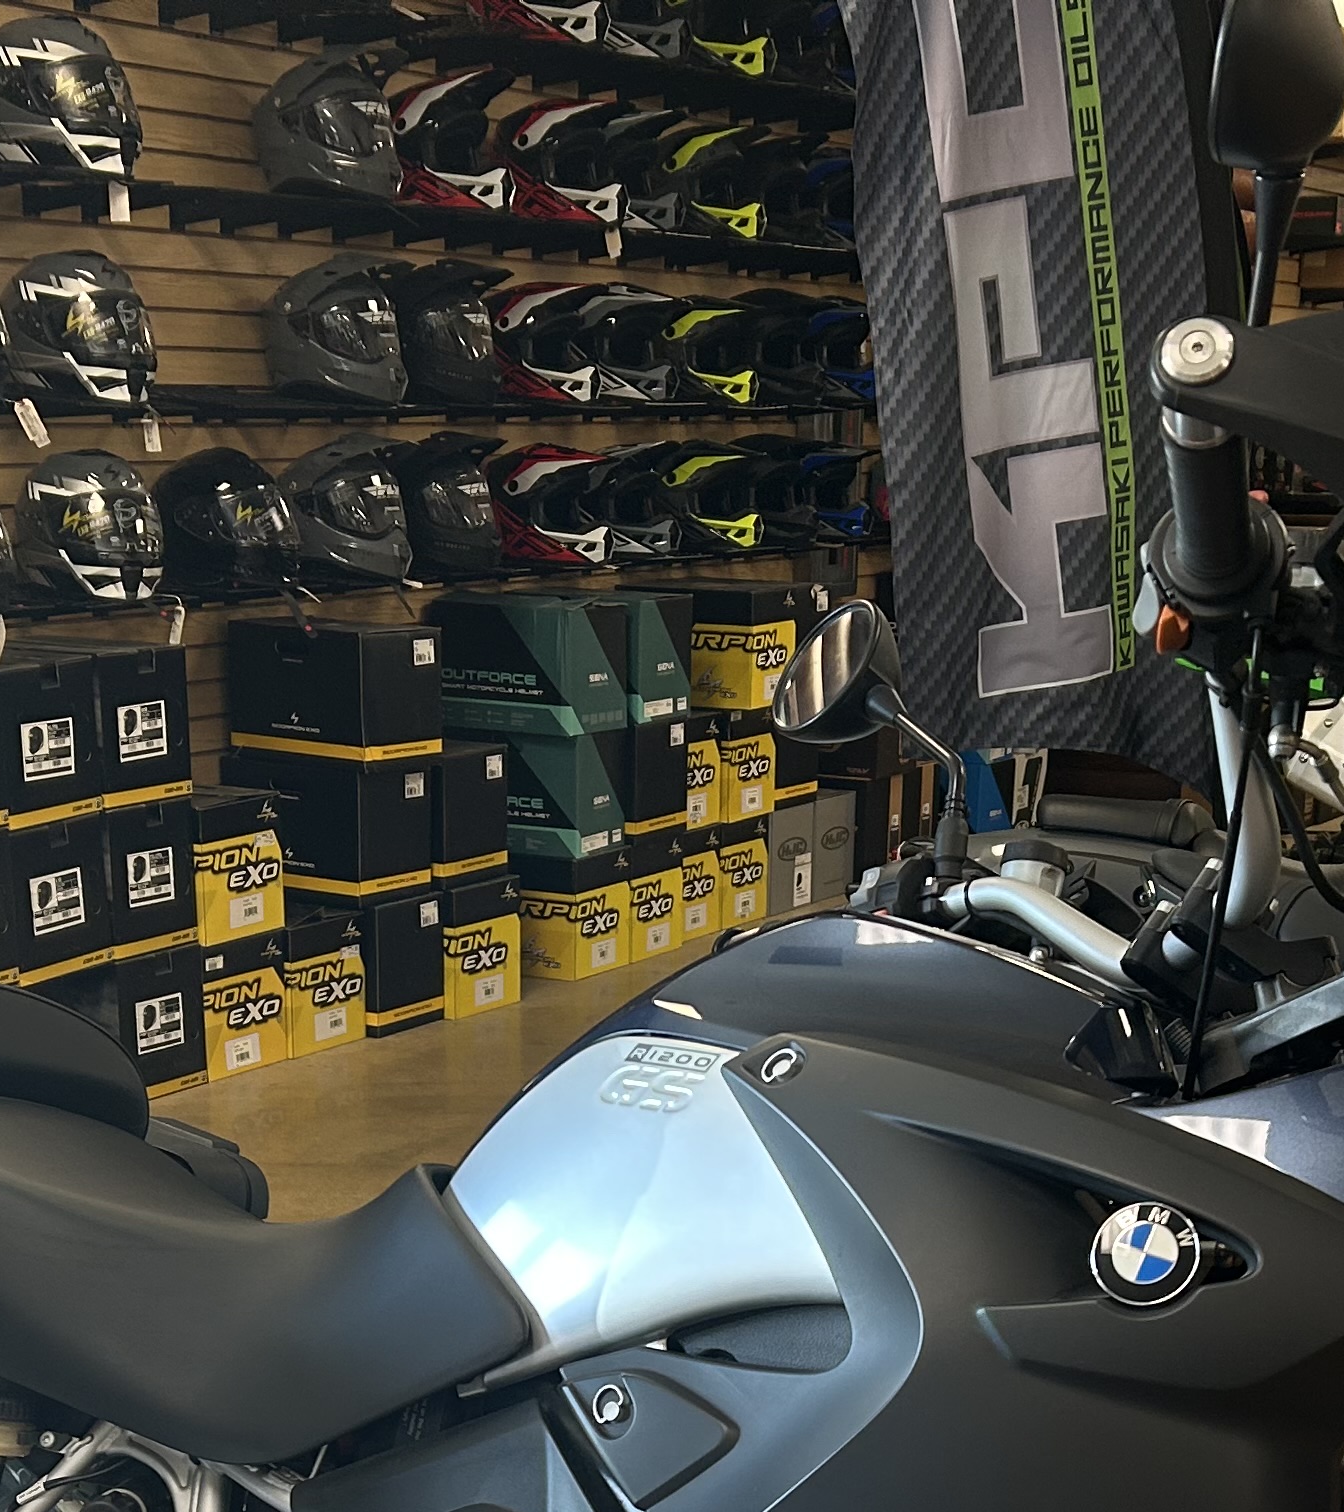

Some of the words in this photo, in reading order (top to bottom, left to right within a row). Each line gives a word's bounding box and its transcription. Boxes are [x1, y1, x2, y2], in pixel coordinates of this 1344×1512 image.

[1077, 106, 1128, 449] PERFORMANCE
[1107, 453, 1133, 669] KAWASAKI
[442, 668, 537, 686] OUTFORCE
[739, 759, 769, 778] EXO
[229, 861, 279, 888] EXO
[732, 865, 762, 885] EXO
[683, 878, 714, 898] EXO
[639, 897, 672, 918] EXO
[582, 912, 618, 935] EXO
[463, 946, 506, 971] EXO
[314, 978, 362, 1003] EXO
[229, 998, 280, 1026] EXO
[628, 1046, 714, 1069] R1200
[600, 1064, 706, 1113] GS
